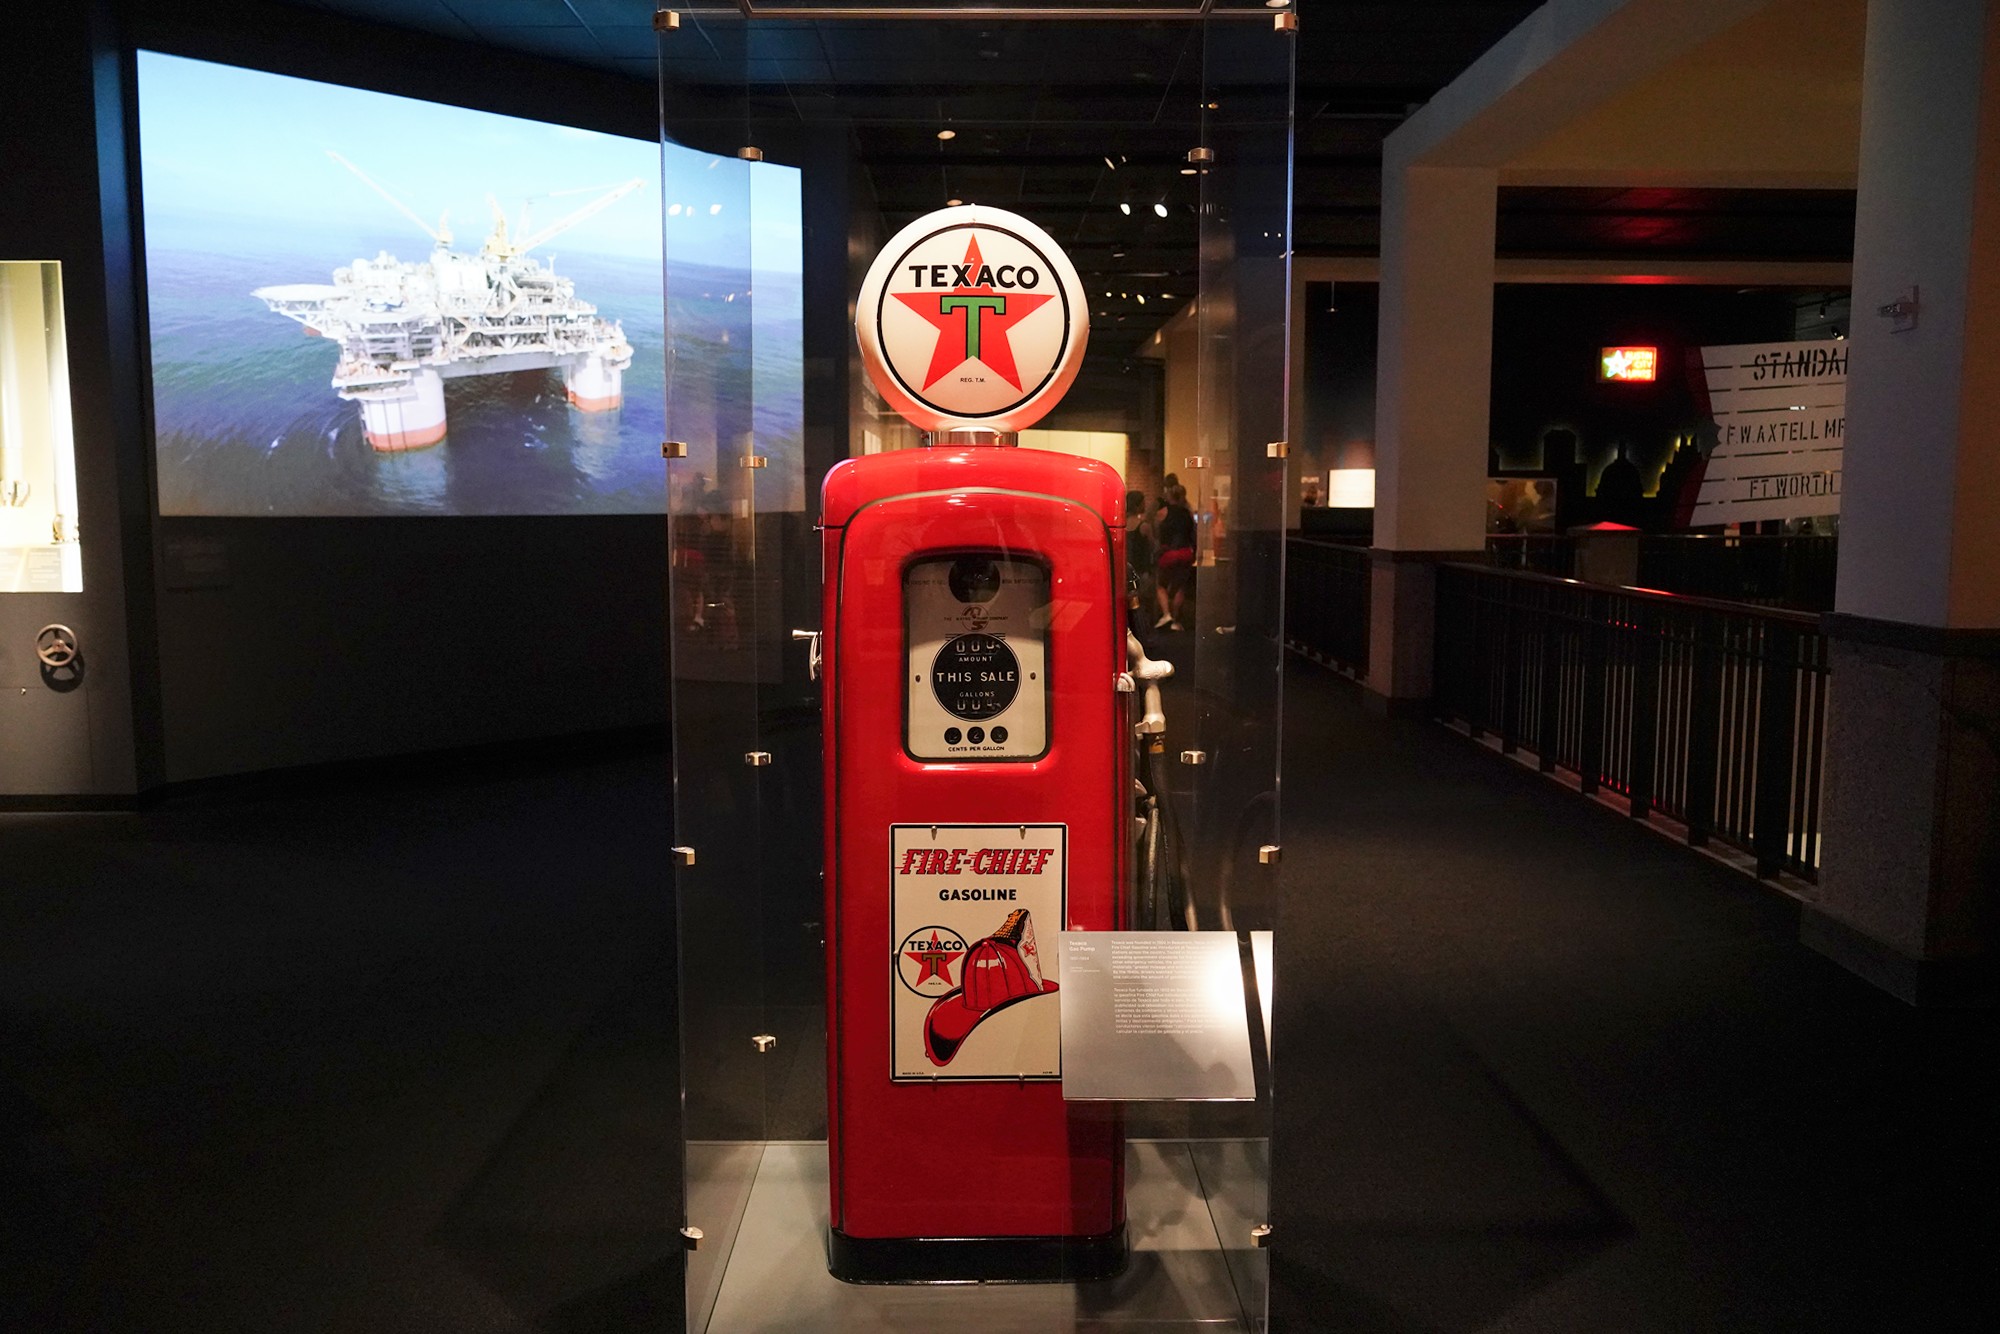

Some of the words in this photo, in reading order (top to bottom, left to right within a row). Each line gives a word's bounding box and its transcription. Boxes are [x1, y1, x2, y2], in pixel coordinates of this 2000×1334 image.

[908, 264, 1040, 290] TEXACO
[939, 295, 1007, 360] T
[1754, 347, 1848, 380] STANDA
[936, 672, 972, 682] THIS
[980, 671, 1015, 682] SALE
[900, 848, 1054, 875] FIRE-CHIEF
[939, 888, 1017, 901] GASOLINE
[909, 940, 963, 951] TEXACO
